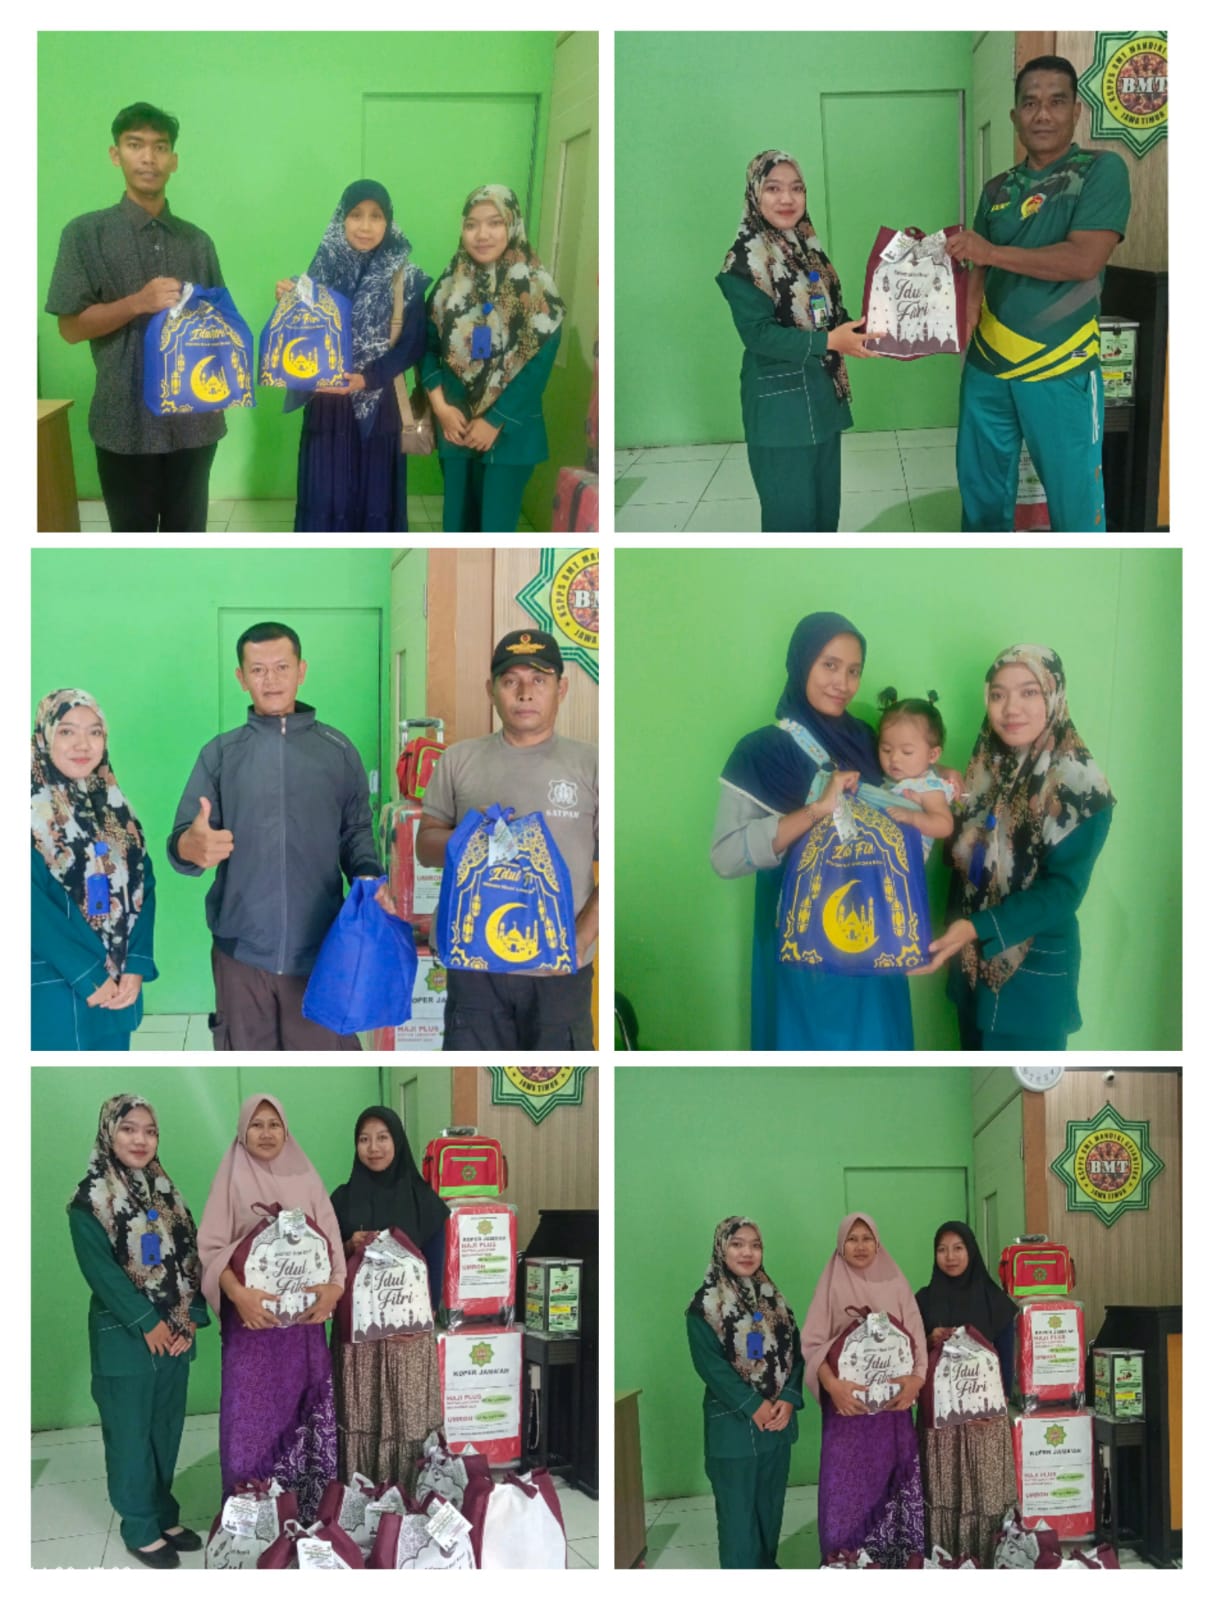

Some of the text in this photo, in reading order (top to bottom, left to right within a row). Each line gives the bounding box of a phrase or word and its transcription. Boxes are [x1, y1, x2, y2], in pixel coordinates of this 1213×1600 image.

[1122, 76, 1168, 93] BMT
[561, 562, 579, 581] BMT
[574, 629, 597, 644] JAWA
[1090, 1160, 1129, 1174] BMT
[272, 1257, 307, 1278] Idul
[374, 1270, 407, 1291] Idul
[377, 1287, 414, 1310] Fitri
[863, 1353, 892, 1371] Idul
[951, 1362, 980, 1381] Idul
[955, 1377, 988, 1398] Fitri
